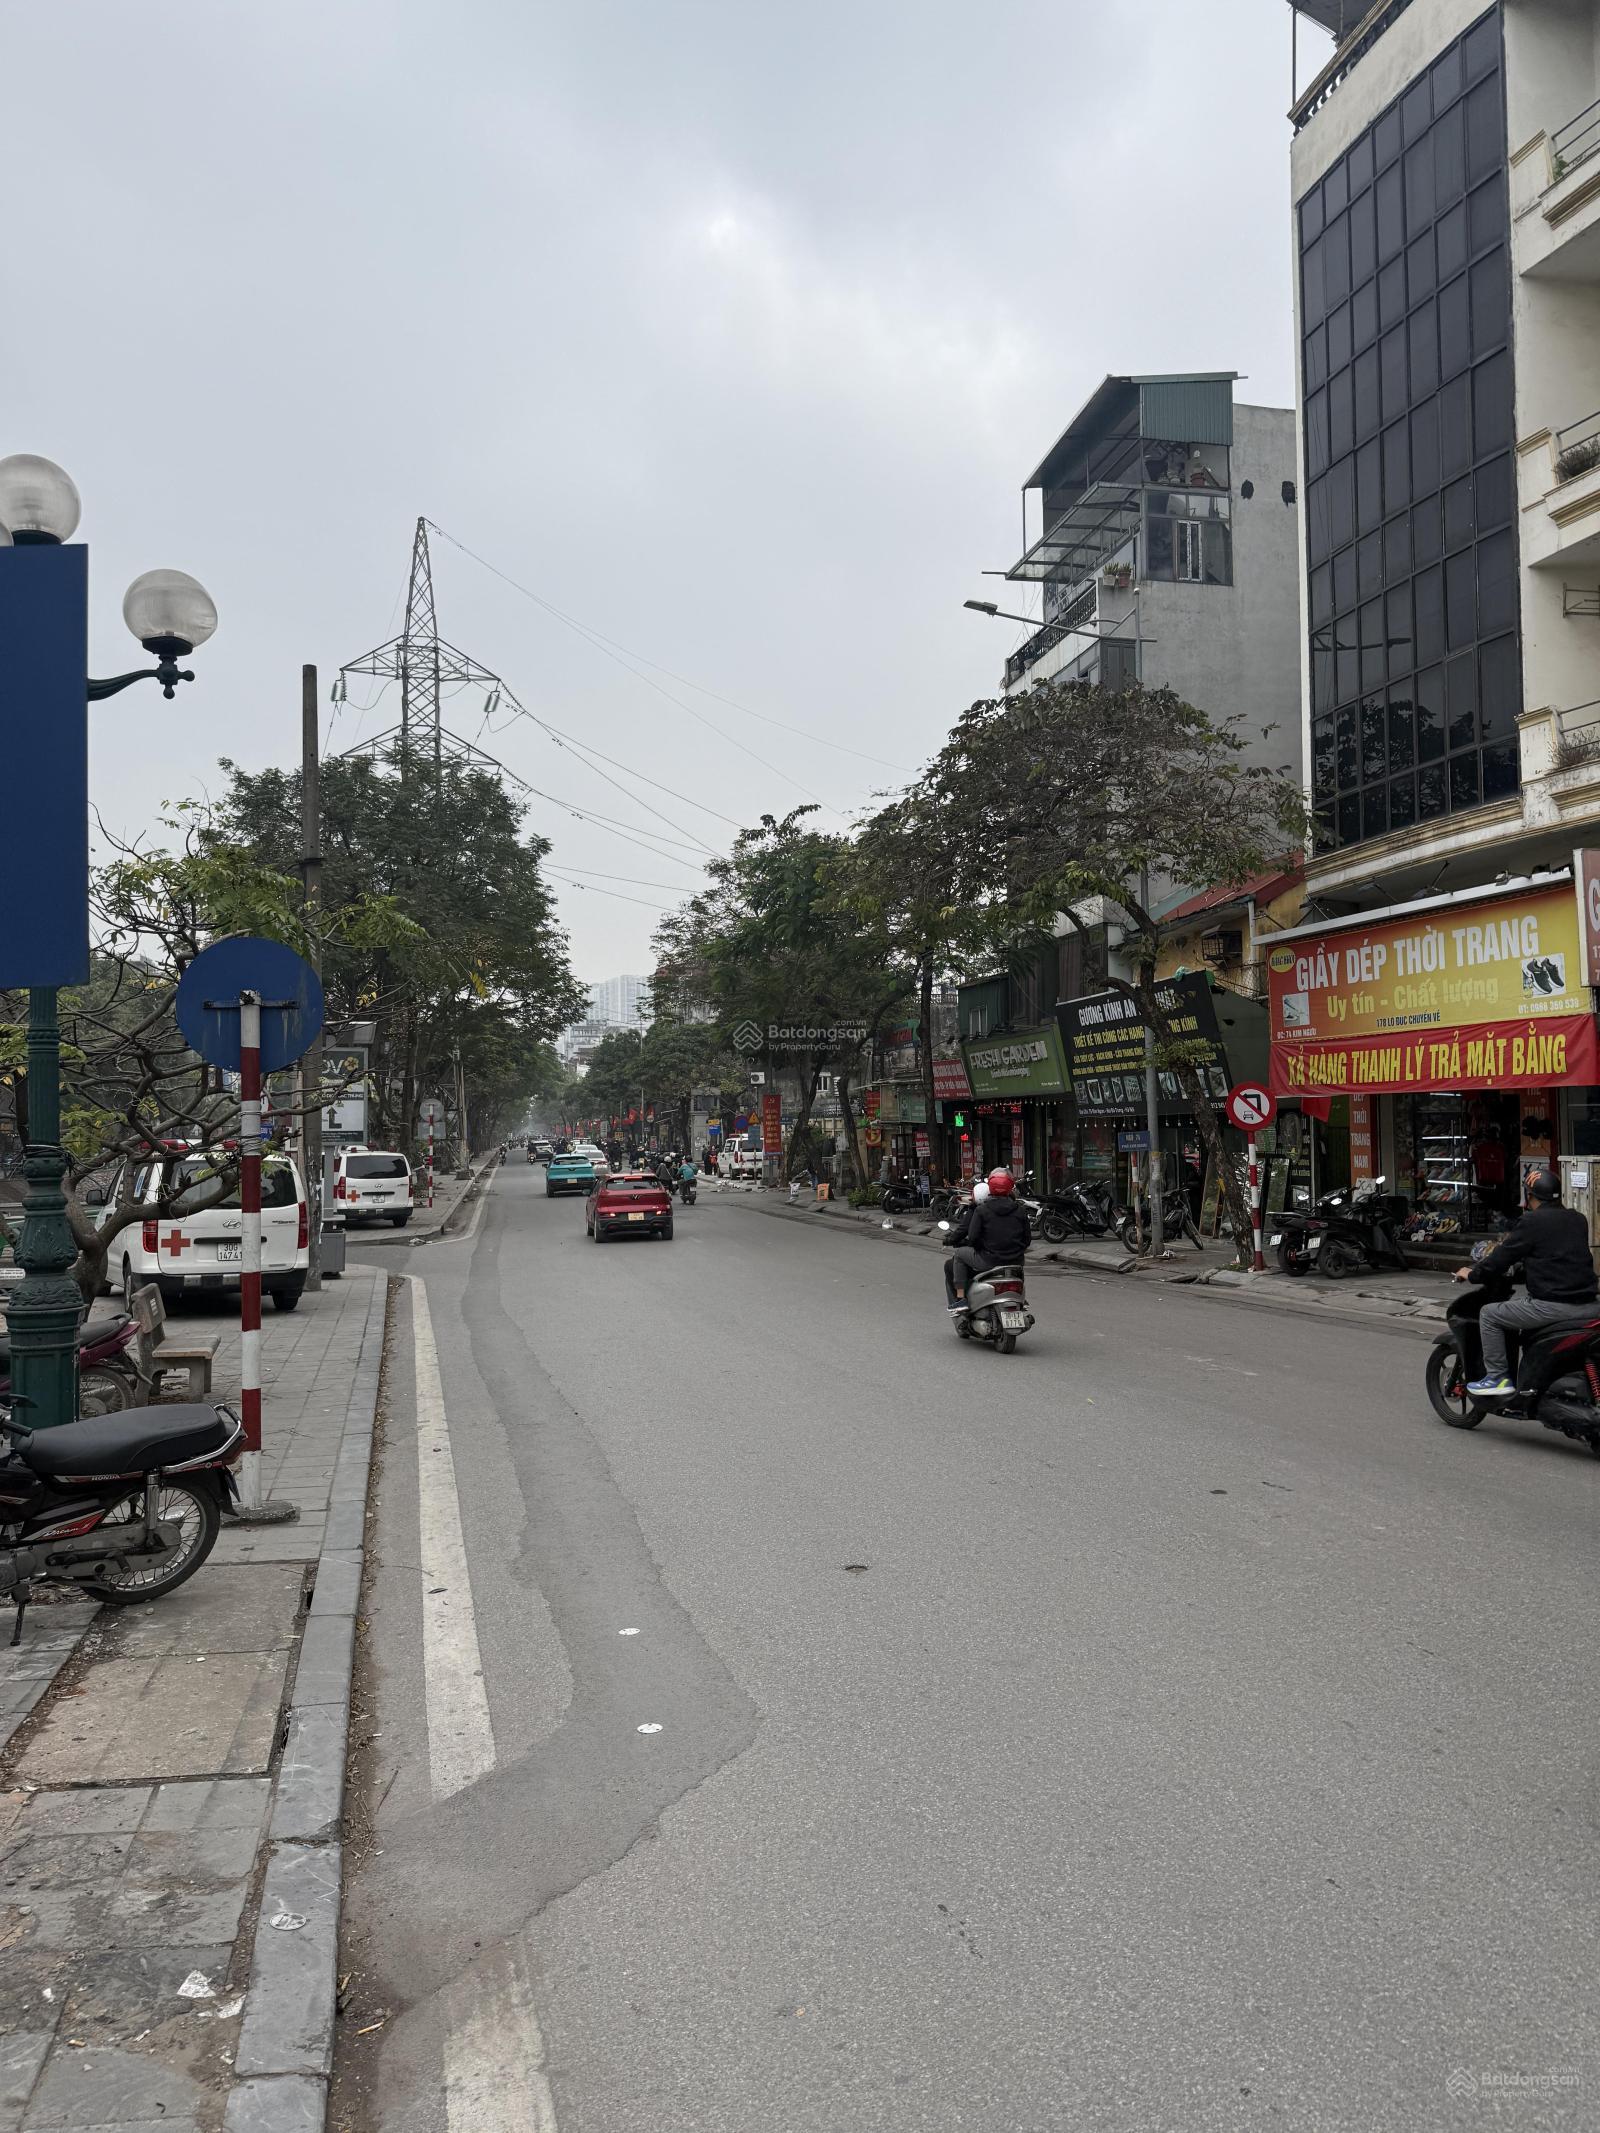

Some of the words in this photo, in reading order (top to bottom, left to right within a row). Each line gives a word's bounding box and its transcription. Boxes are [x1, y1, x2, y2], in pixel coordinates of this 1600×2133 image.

[1296, 942, 1340, 992] GIẦY
[1346, 939, 1387, 985] DÉP
[1394, 925, 1446, 977] THỜI
[1453, 915, 1540, 967] TRANG
[1103, 998, 1124, 1021] KÍNH
[1327, 995, 1347, 1022] Uy
[1352, 990, 1375, 1015] tín
[1394, 977, 1438, 1010] Chất
[1443, 978, 1500, 1007] lượng
[1001, 1040, 1048, 1066] GARDEN
[1287, 1044, 1305, 1086] XẢ
[1309, 1047, 1347, 1085] HÀNG
[1351, 1047, 1401, 1083] THANH
[1405, 1038, 1424, 1081] LÝ
[1429, 1031, 1461, 1080] TRẢ
[1467, 1031, 1507, 1085] MẶT
[1512, 1021, 1567, 1076] BẰNG
[1353, 1155, 1369, 1169] NAM
